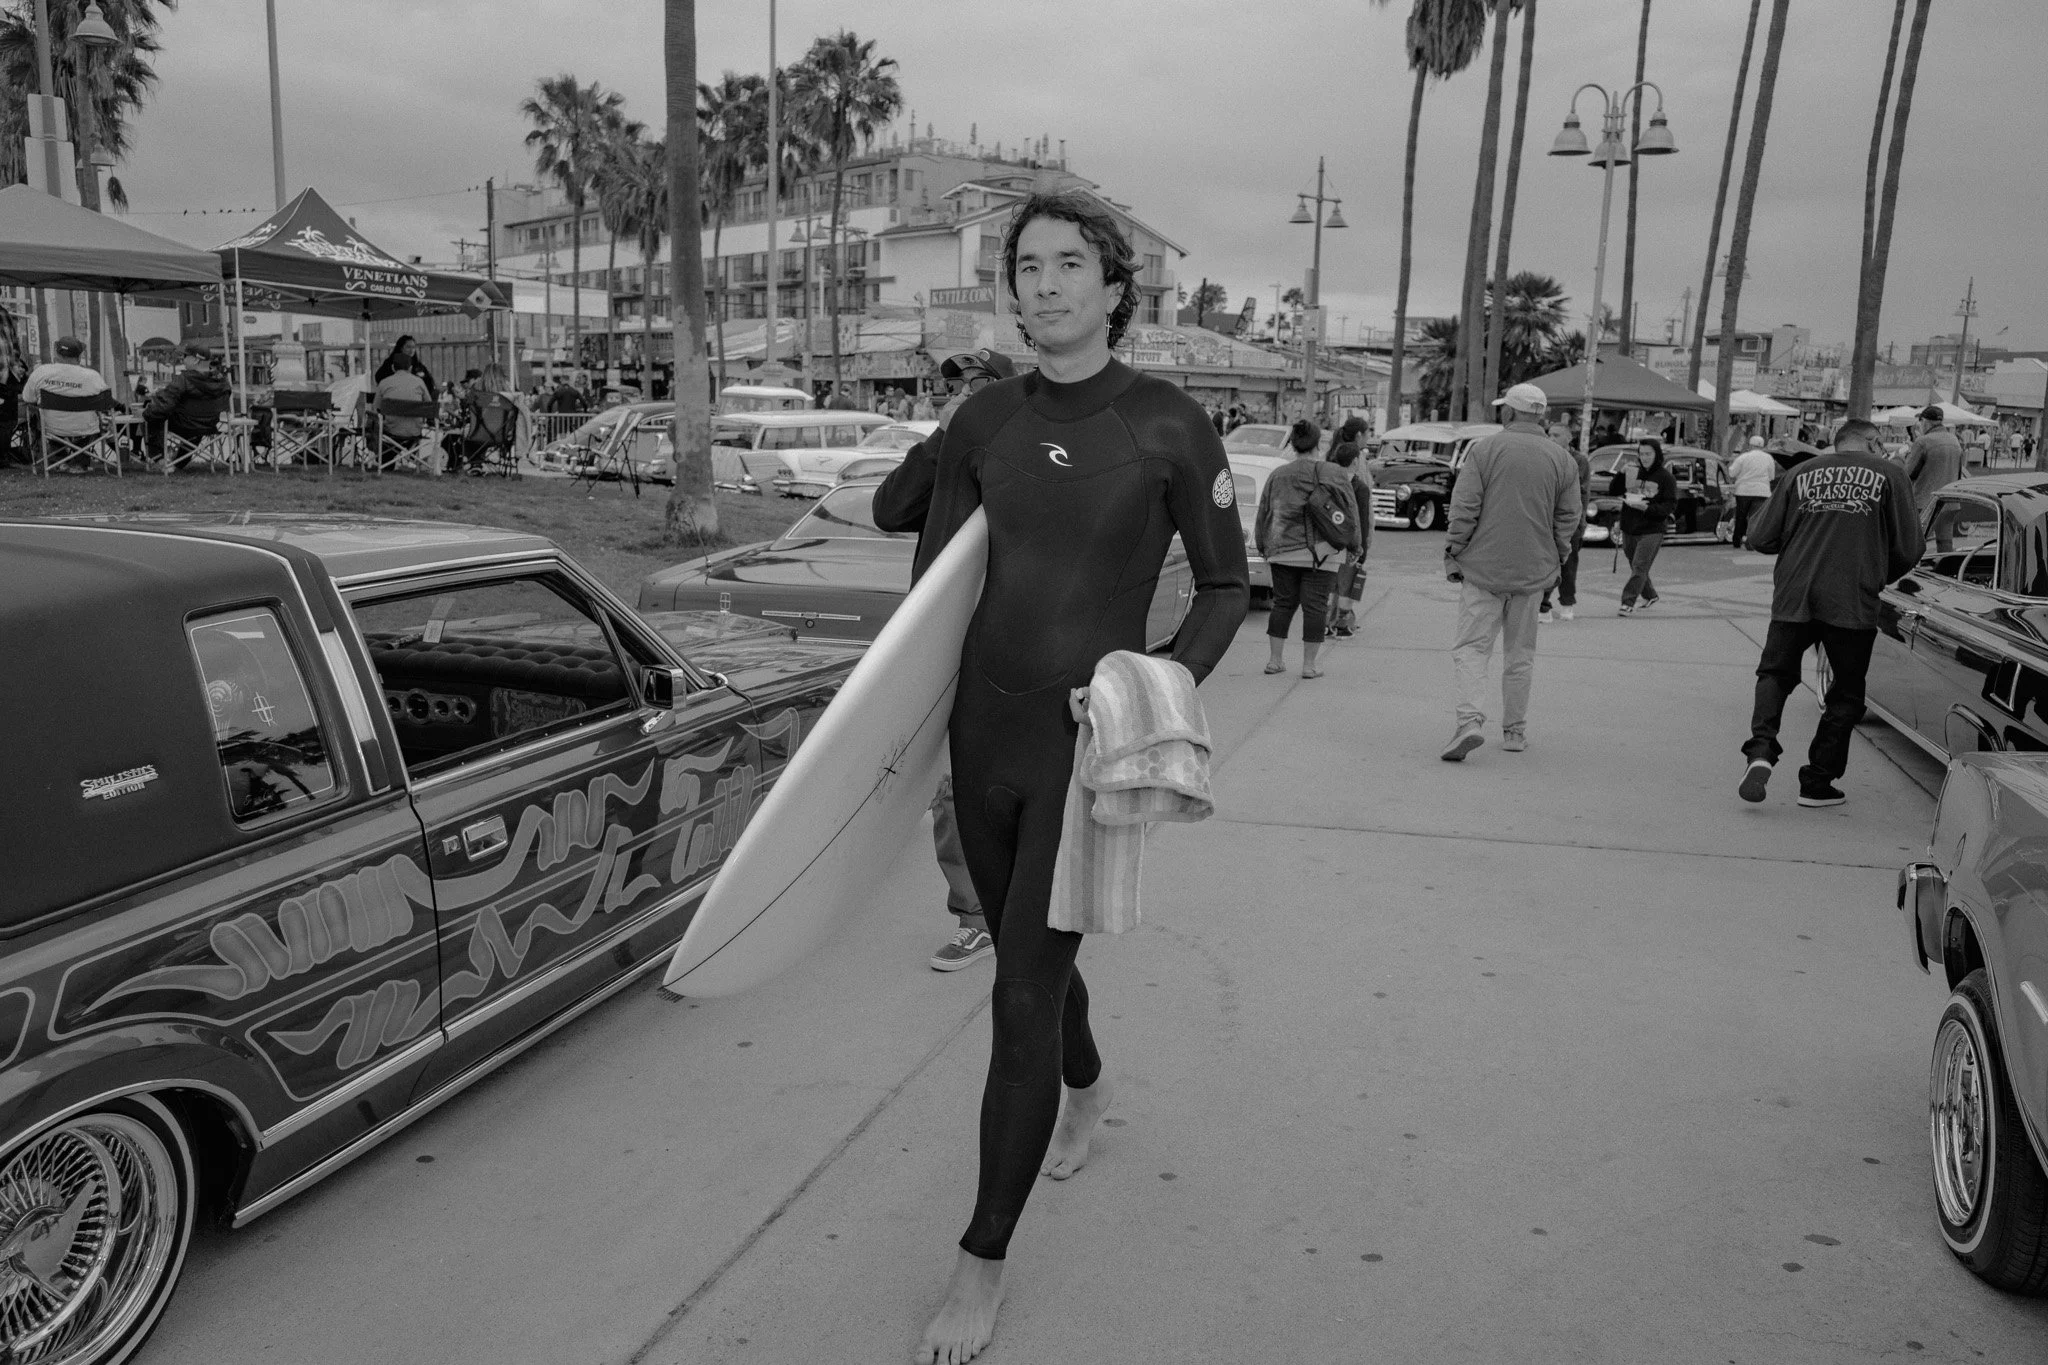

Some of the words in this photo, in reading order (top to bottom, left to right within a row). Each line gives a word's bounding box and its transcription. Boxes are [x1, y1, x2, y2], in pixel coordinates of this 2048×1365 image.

[342, 266, 428, 288] VENETIANS
[370, 284, 384, 292] CAR
[385, 284, 402, 294] CLUB
[932, 289, 968, 305] KETTLE
[1796, 466, 1886, 502] WESTSIDE
[1806, 484, 1869, 500] CLASSICS
[103, 782, 145, 800] EDITION
